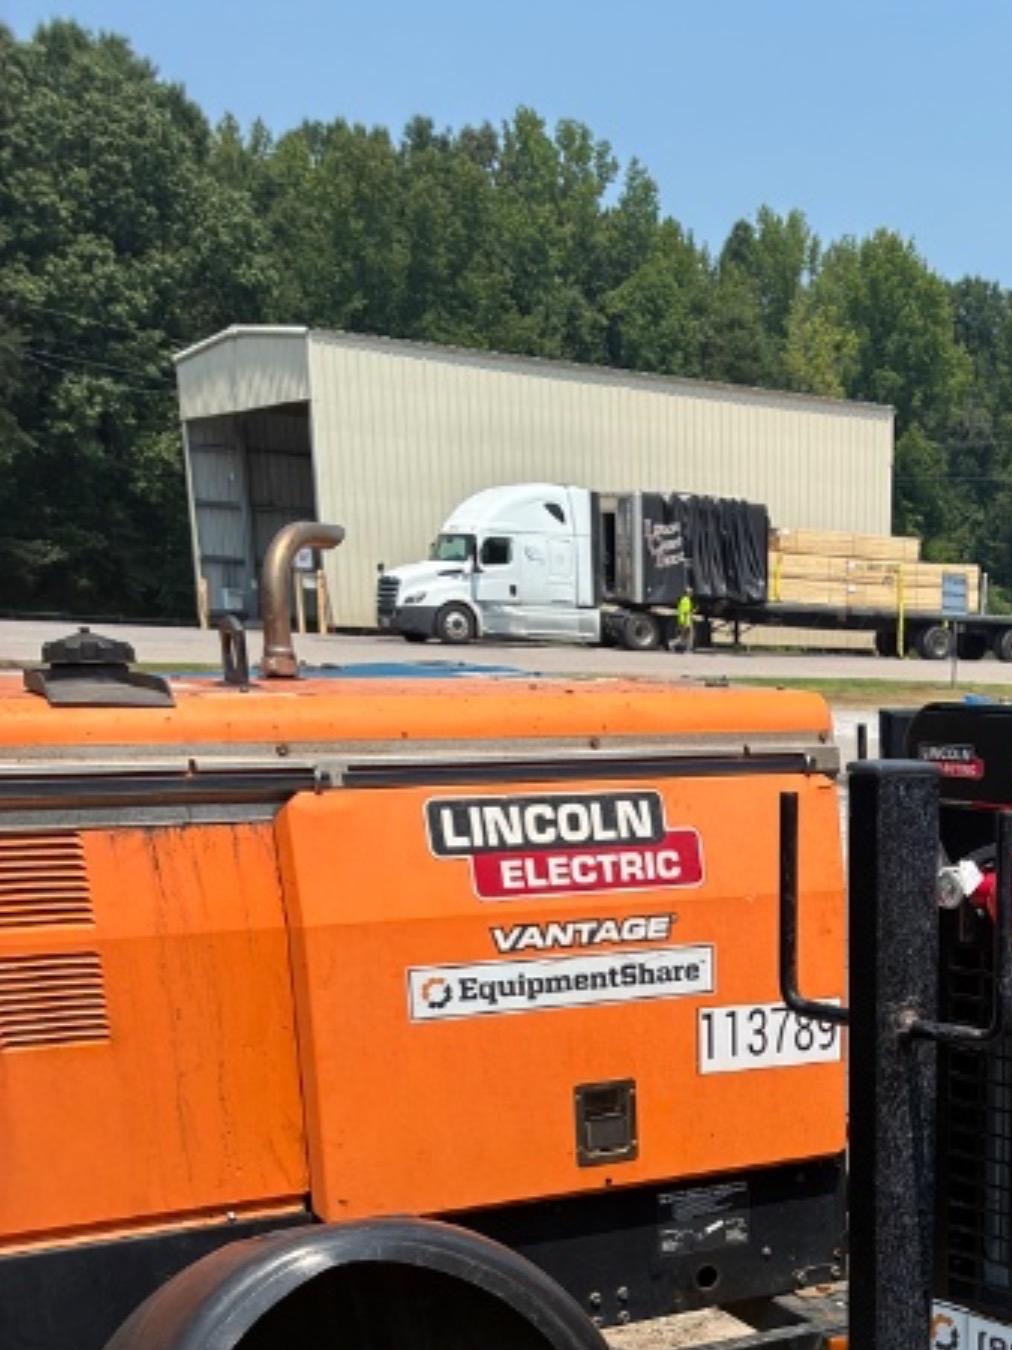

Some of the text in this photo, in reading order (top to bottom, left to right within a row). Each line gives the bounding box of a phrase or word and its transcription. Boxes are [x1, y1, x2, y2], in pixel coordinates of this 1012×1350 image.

[440, 799, 652, 848] LINCOLN
[500, 850, 681, 890] ELECTRIC
[492, 915, 673, 952] VANTAGE
[457, 962, 700, 1001] EquipmentShare
[701, 1008, 837, 1060] 113789
